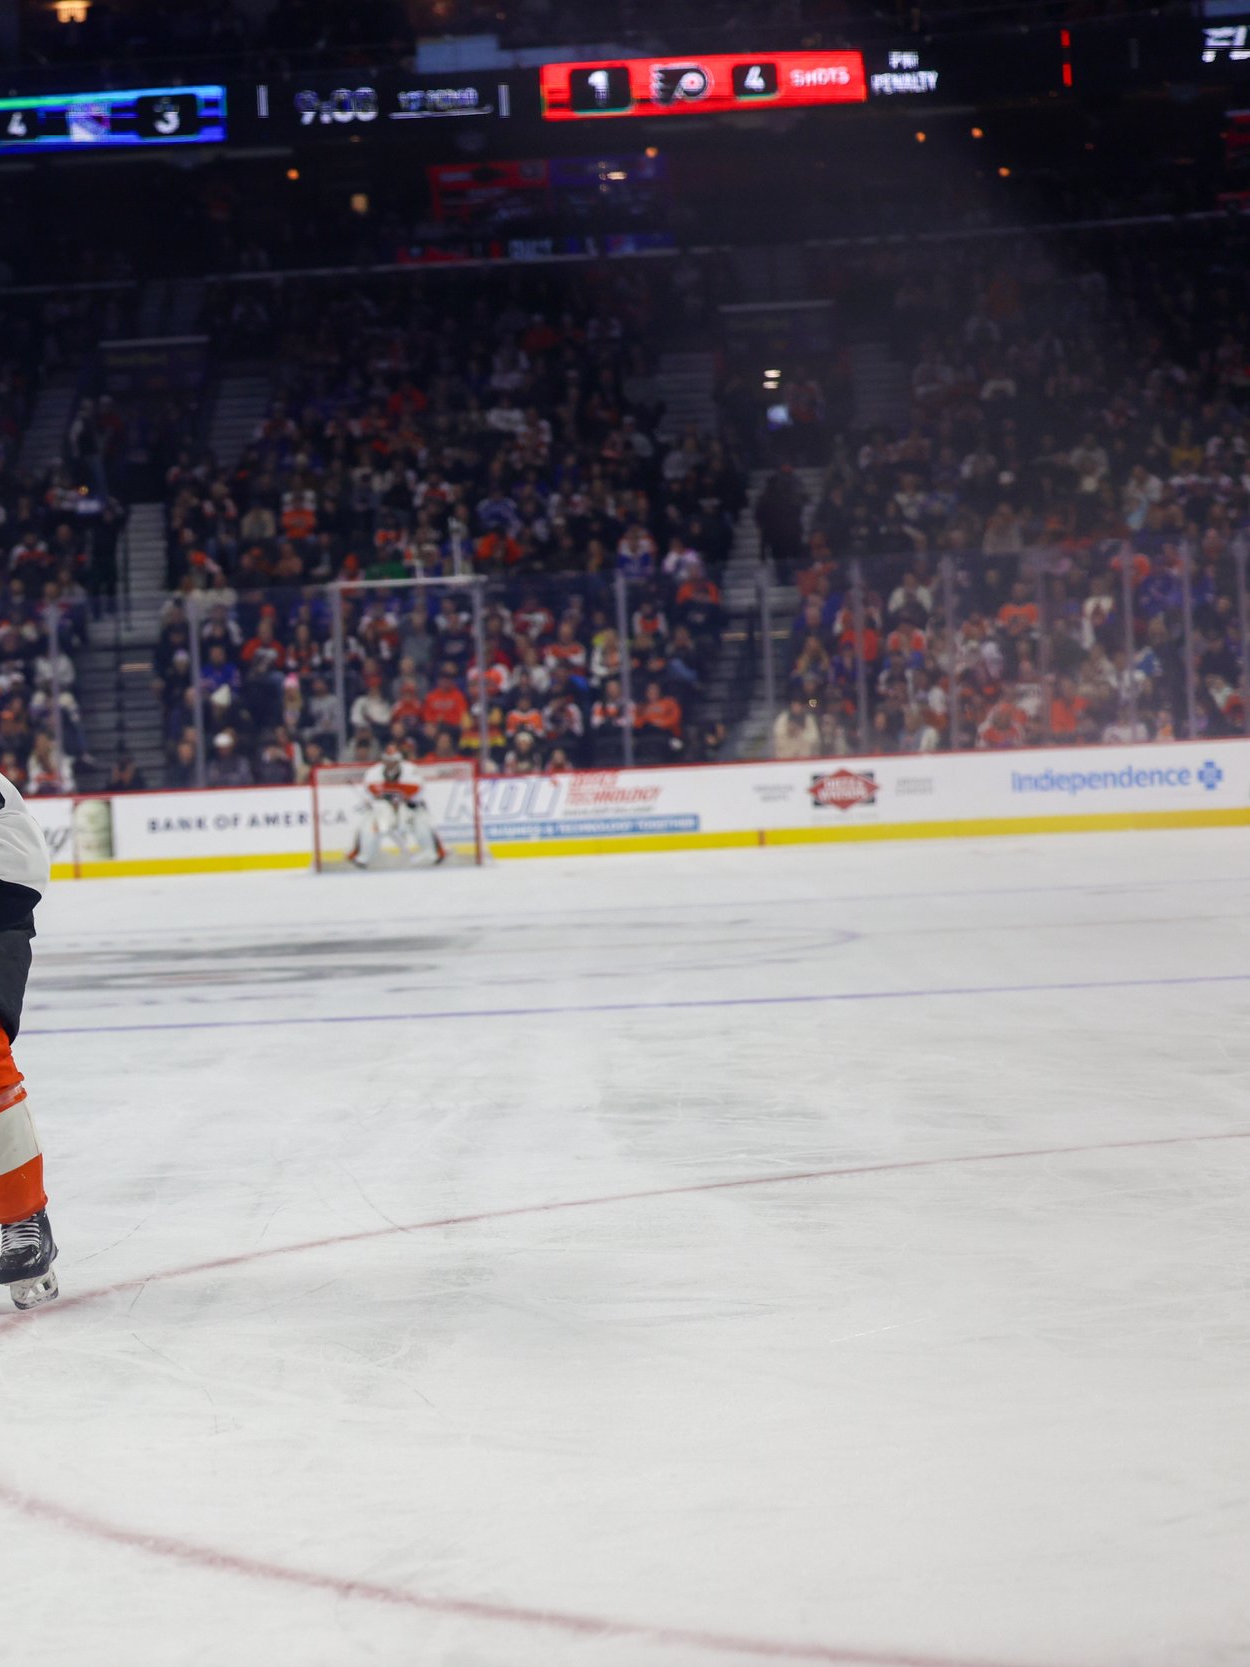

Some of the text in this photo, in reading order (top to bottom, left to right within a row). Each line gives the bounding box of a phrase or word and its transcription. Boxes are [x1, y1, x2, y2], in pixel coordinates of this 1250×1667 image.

[1201, 25, 1250, 63] FL
[744, 65, 850, 92] 4 SHOTS
[7, 112, 28, 137] 4
[1011, 766, 1191, 796] Independence
[147, 809, 347, 833] BANK OF AMERCA
